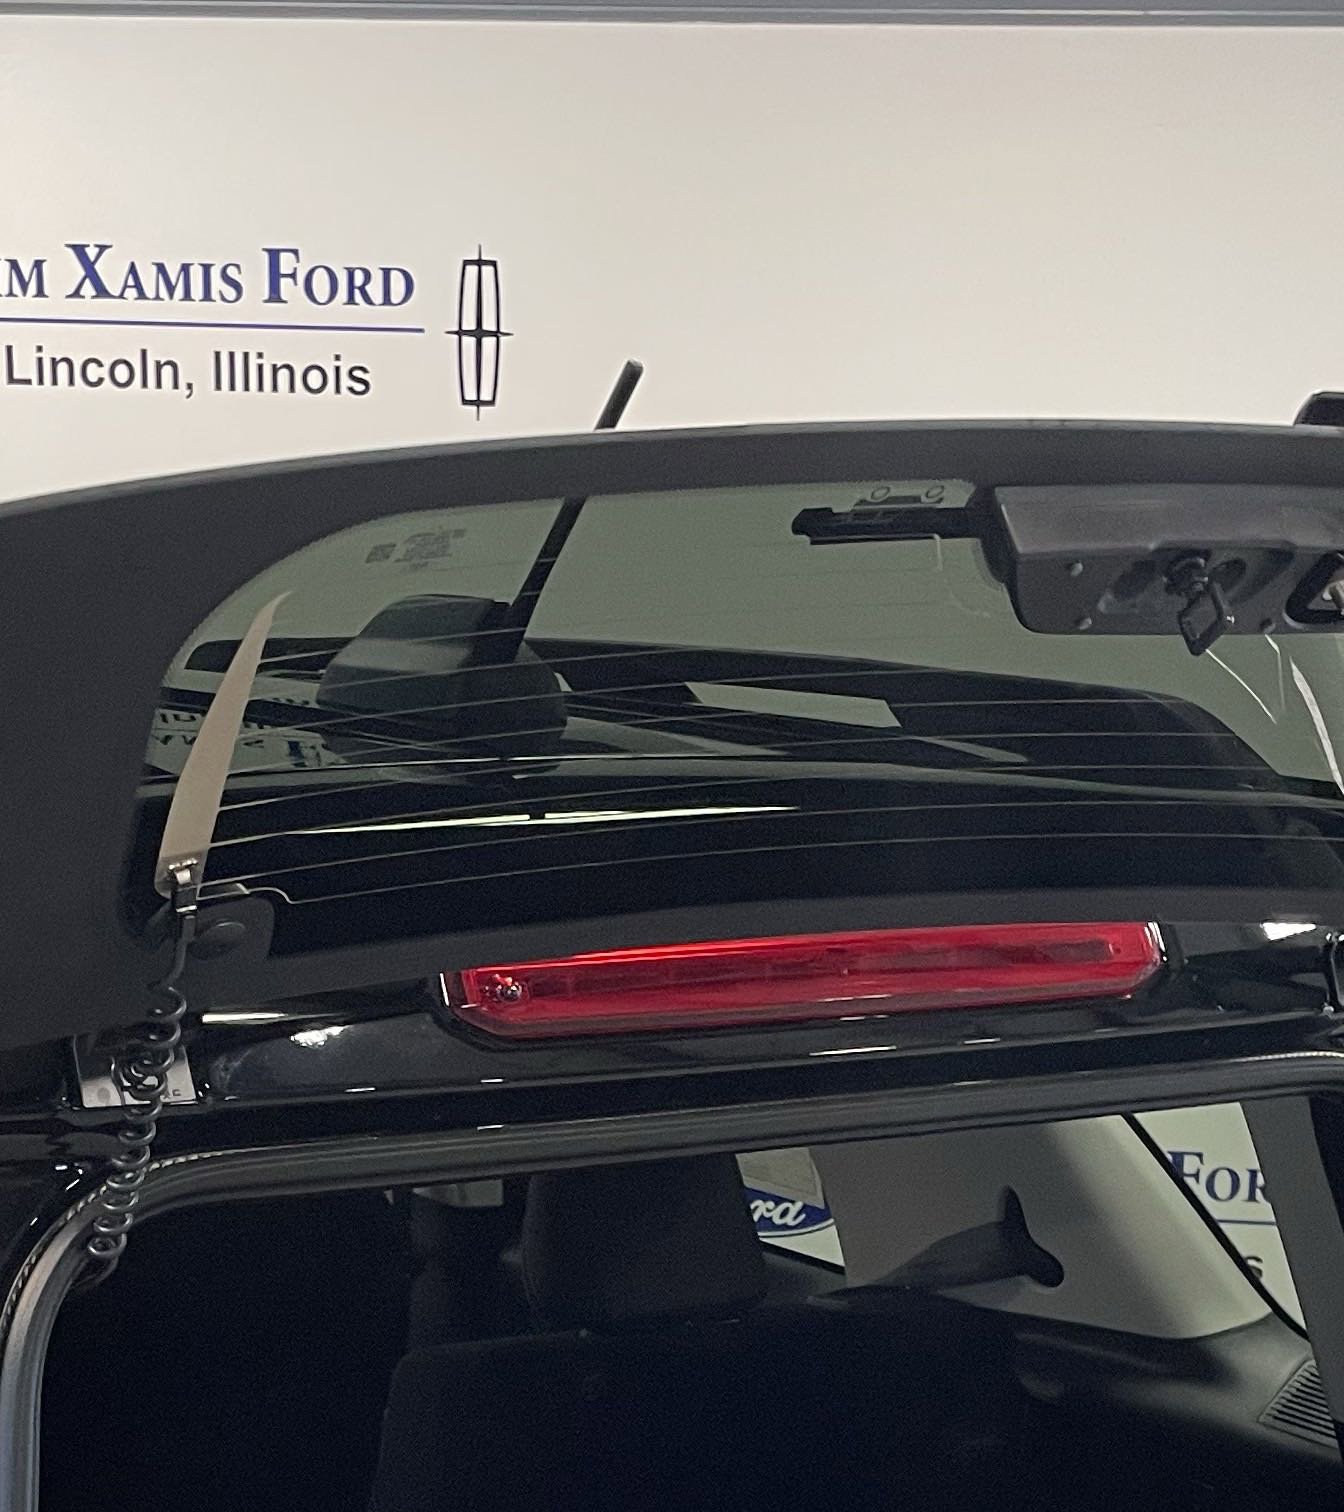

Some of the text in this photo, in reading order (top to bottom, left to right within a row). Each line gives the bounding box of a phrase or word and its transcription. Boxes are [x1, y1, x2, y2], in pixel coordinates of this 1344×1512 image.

[65, 243, 244, 304] XAMIS
[261, 247, 415, 307] FORD
[5, 344, 372, 399] Lincoln, Illinois
[1167, 1151, 1266, 1203] FOR
